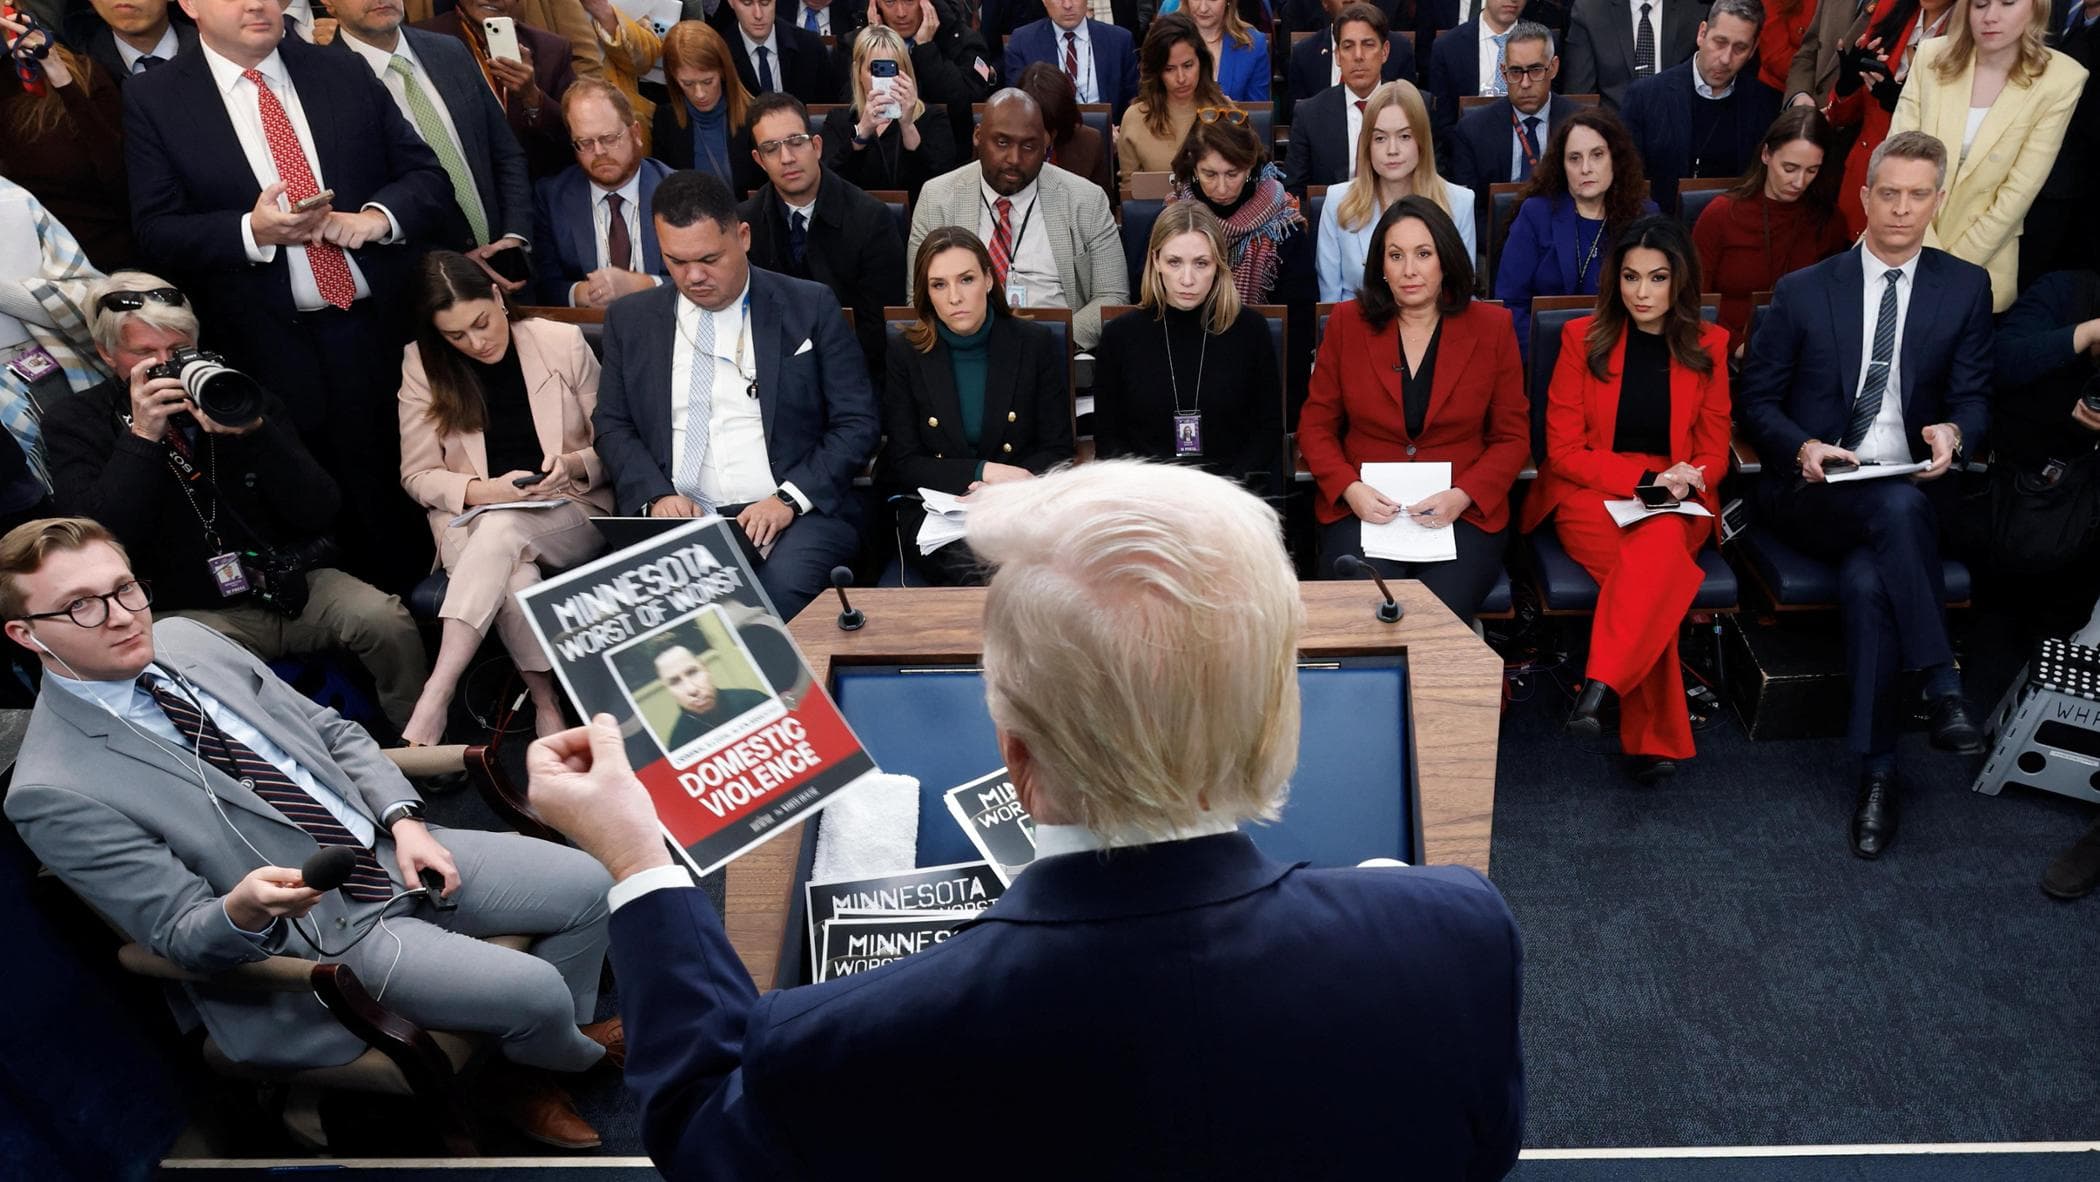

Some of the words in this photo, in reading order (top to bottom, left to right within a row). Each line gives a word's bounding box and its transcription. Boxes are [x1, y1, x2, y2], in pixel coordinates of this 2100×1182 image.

[551, 544, 722, 633] MINNESOTA
[556, 613, 635, 662] WORST
[635, 599, 667, 628] OF
[665, 566, 744, 612] WORST
[677, 717, 807, 798] DOMESTIC
[699, 741, 822, 818] VIOLENCE
[977, 801, 1025, 828] WOR
[832, 876, 986, 910] MINNESOTA
[849, 930, 959, 957] MINNES
